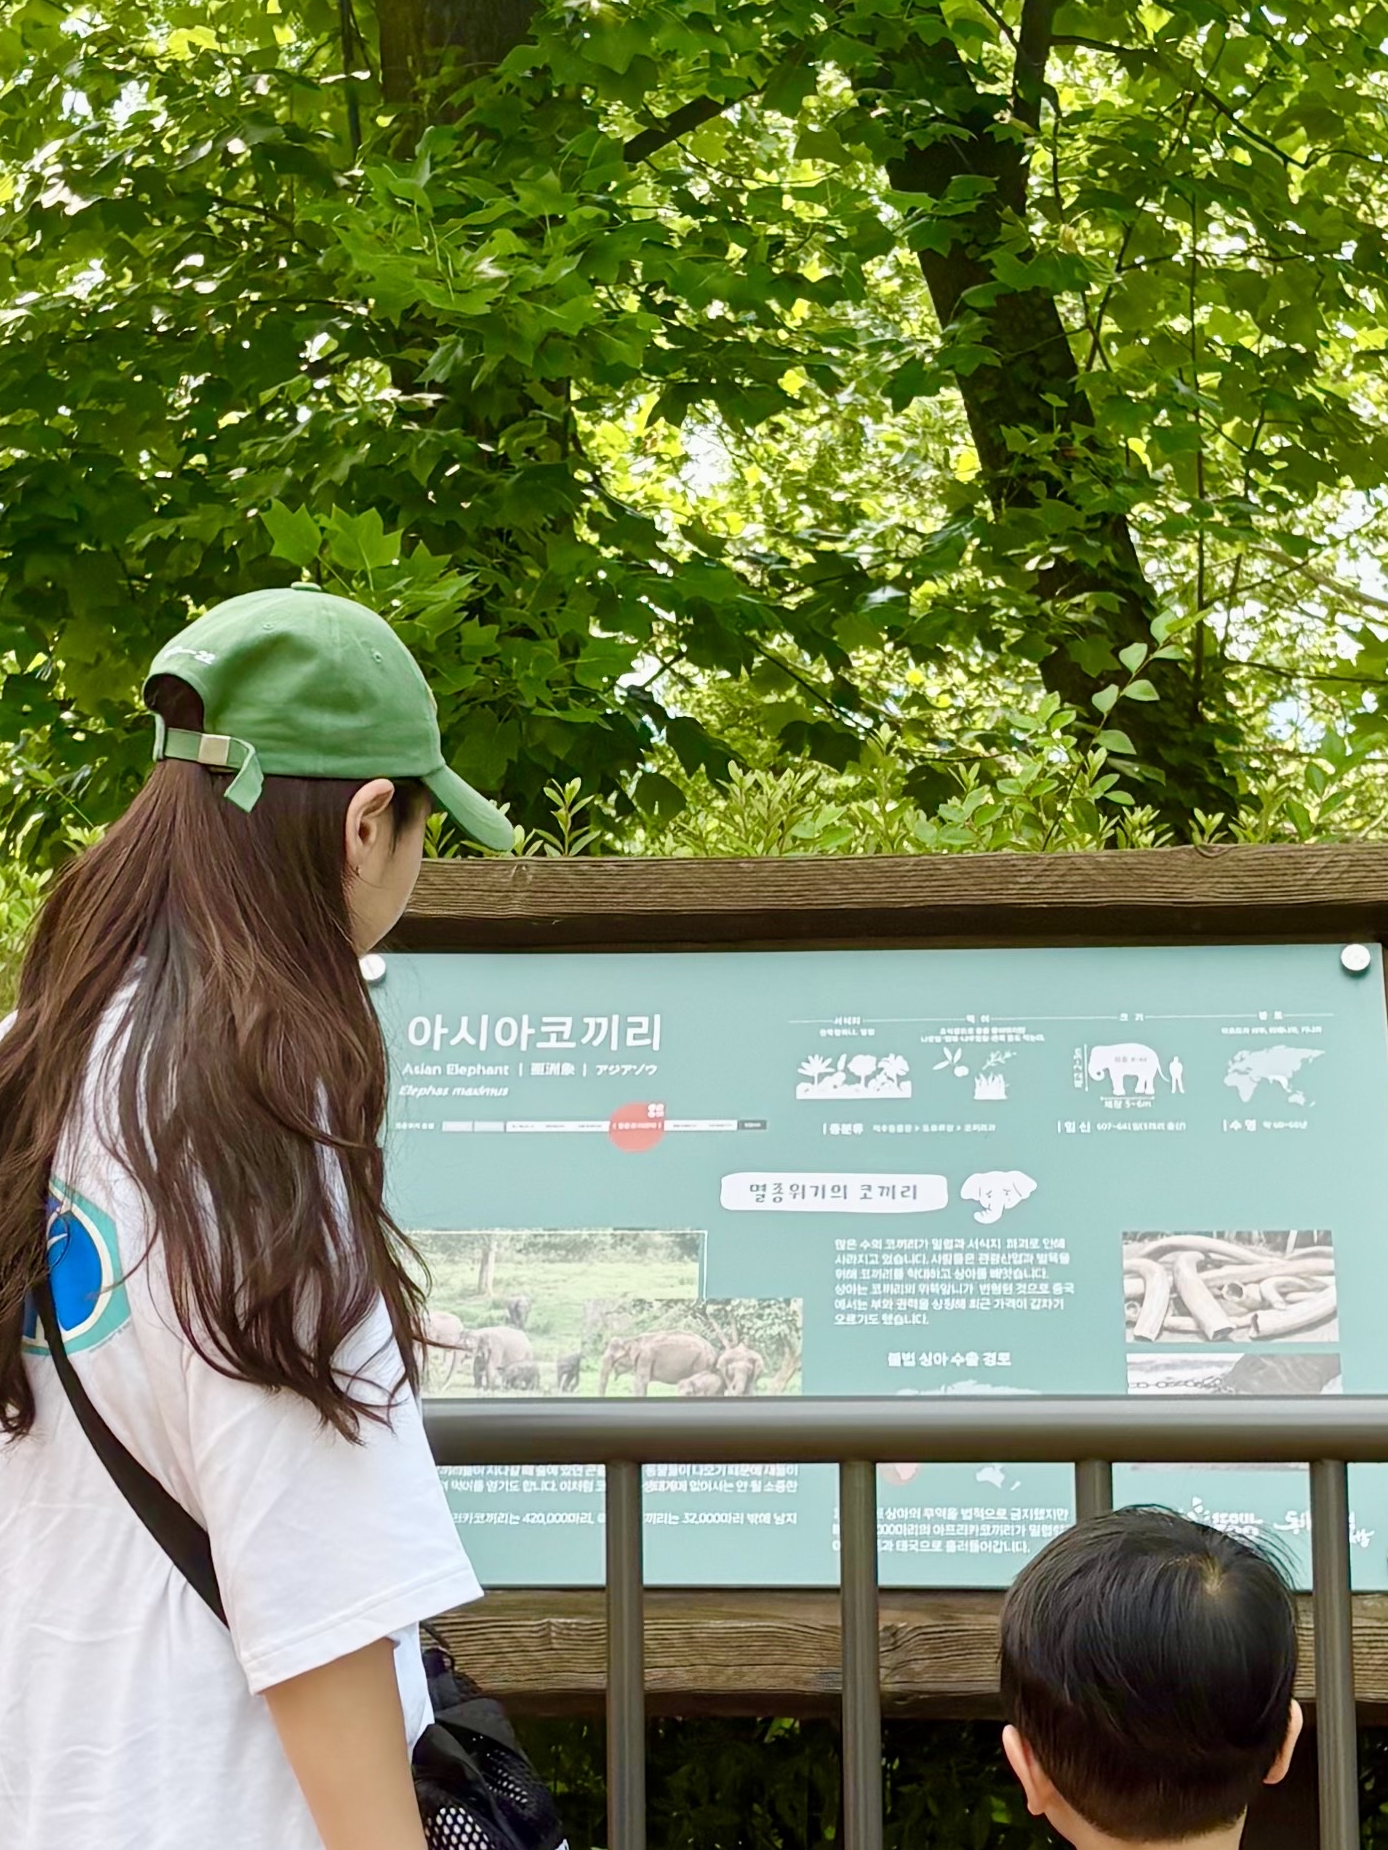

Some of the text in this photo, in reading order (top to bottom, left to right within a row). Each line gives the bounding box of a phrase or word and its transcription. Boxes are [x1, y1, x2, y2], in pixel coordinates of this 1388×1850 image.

[407, 1013, 662, 1051] 아시아코끼리
[402, 1062, 510, 1077] Asian Elephant
[398, 1085, 509, 1098] Elephas maximus
[749, 1182, 918, 1204] 멸종위기의 코끼리
[859, 1238, 883, 1251] 수의
[884, 1238, 929, 1251] 코끼리가
[967, 1238, 1002, 1251] 서식지
[1042, 1238, 1065, 1251] 인해
[834, 1252, 880, 1265] 사라지고
[882, 1252, 929, 1265] 있습니다.
[859, 1267, 904, 1280] 코끼리를
[906, 1267, 952, 1280] 학대하고
[953, 1267, 987, 1280] 상아를
[834, 1282, 869, 1295] 상아는
[869, 1282, 916, 1295] 코끼리의
[1015, 1282, 1051, 1295] 것으로
[1052, 1282, 1075, 1295] 중국
[834, 1298, 868, 1311] 에서는
[870, 1298, 894, 1311] 부와
[931, 1298, 967, 1311] 상징해
[968, 1298, 992, 1311] 최근
[992, 1298, 1028, 1311] 가격이
[1029, 1298, 1065, 1311] 갑자기
[834, 1313, 880, 1326] 오르기도
[887, 1351, 1012, 1368] 불법 상아 수출 경로
[438, 1464, 485, 1477] 끼리들이
[522, 1480, 558, 1493] 합니다.
[559, 1480, 594, 1493] 이처럼
[689, 1480, 734, 1493] 없어서는
[763, 1480, 798, 1493] 소중한
[453, 1512, 521, 1525] 리카코끼리는
[773, 1512, 798, 1525] 남지
[885, 1507, 921, 1521] 상아의
[961, 1507, 1008, 1521] 법적으로
[1010, 1507, 1069, 1521] 금지했지만
[895, 1539, 943, 1553] 태국으로
